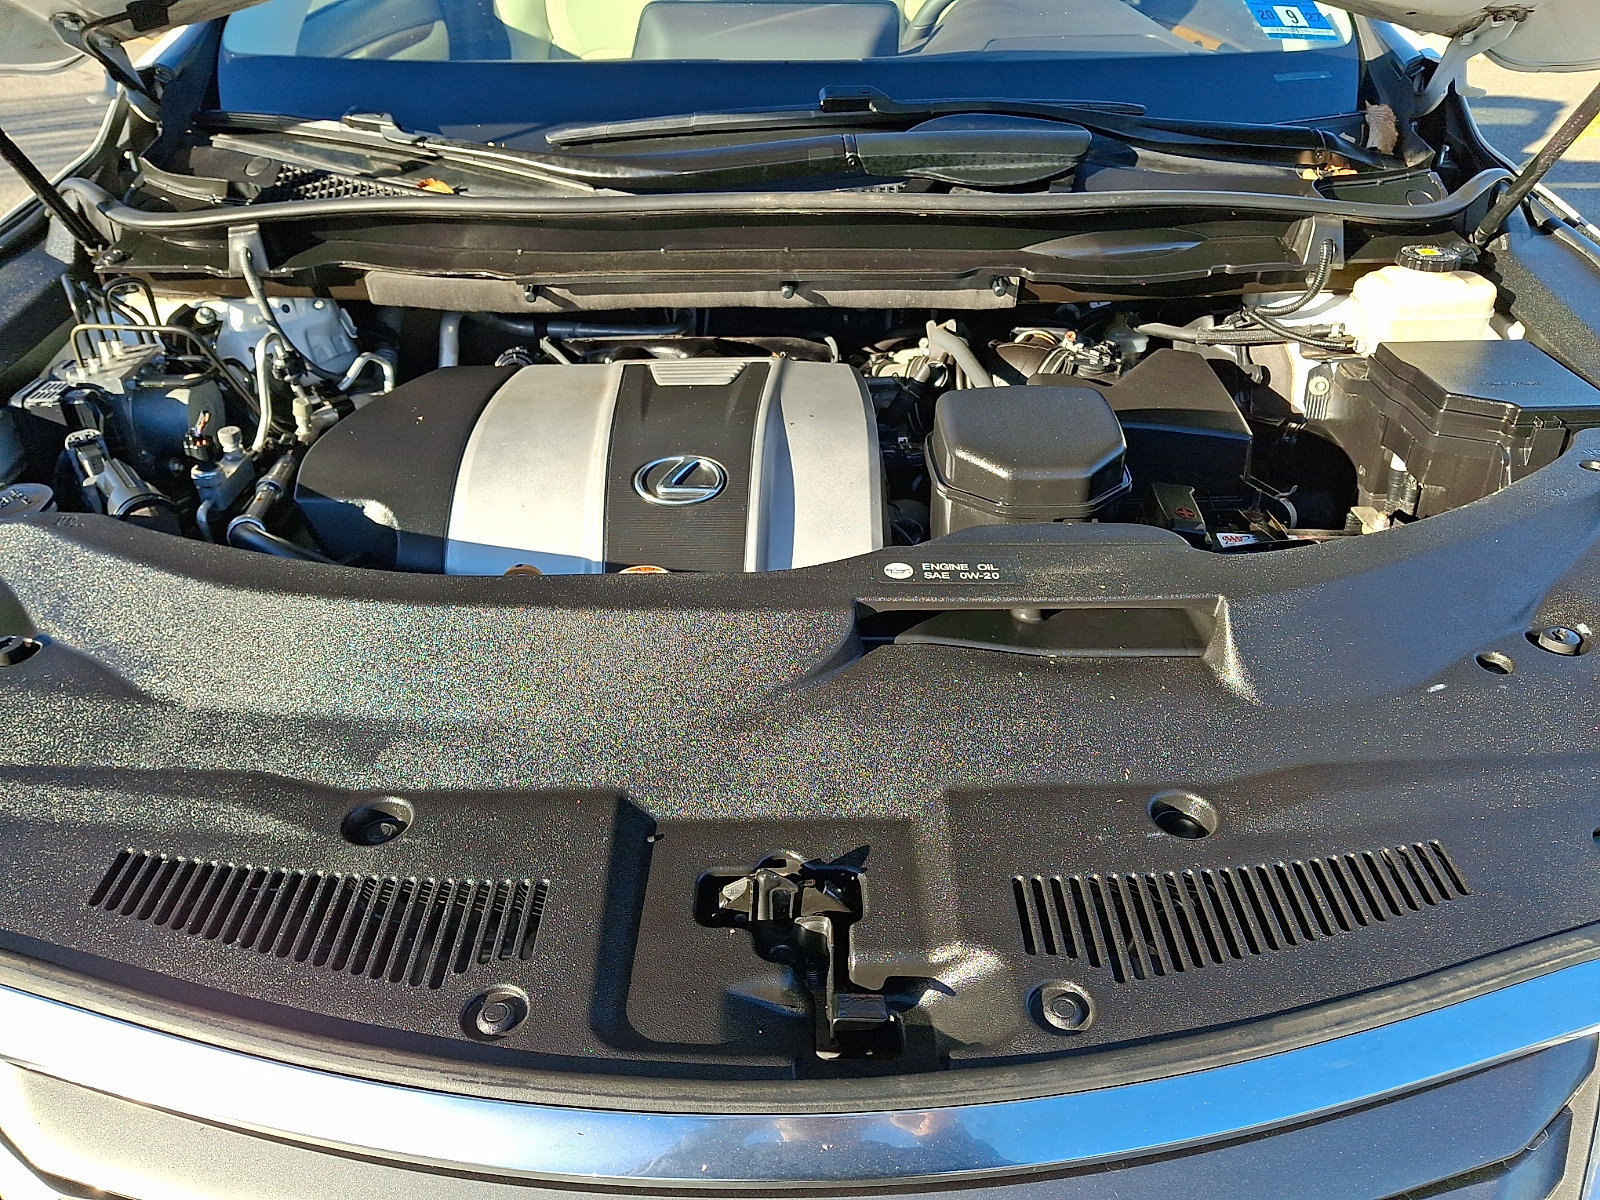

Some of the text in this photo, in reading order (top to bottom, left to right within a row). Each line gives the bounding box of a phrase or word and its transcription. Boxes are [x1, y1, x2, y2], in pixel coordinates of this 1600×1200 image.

[1257, 9, 1322, 24] 20 9 27
[922, 563, 1000, 571] ENGINE OIL
[924, 572, 1000, 580] SAE 0W-20
